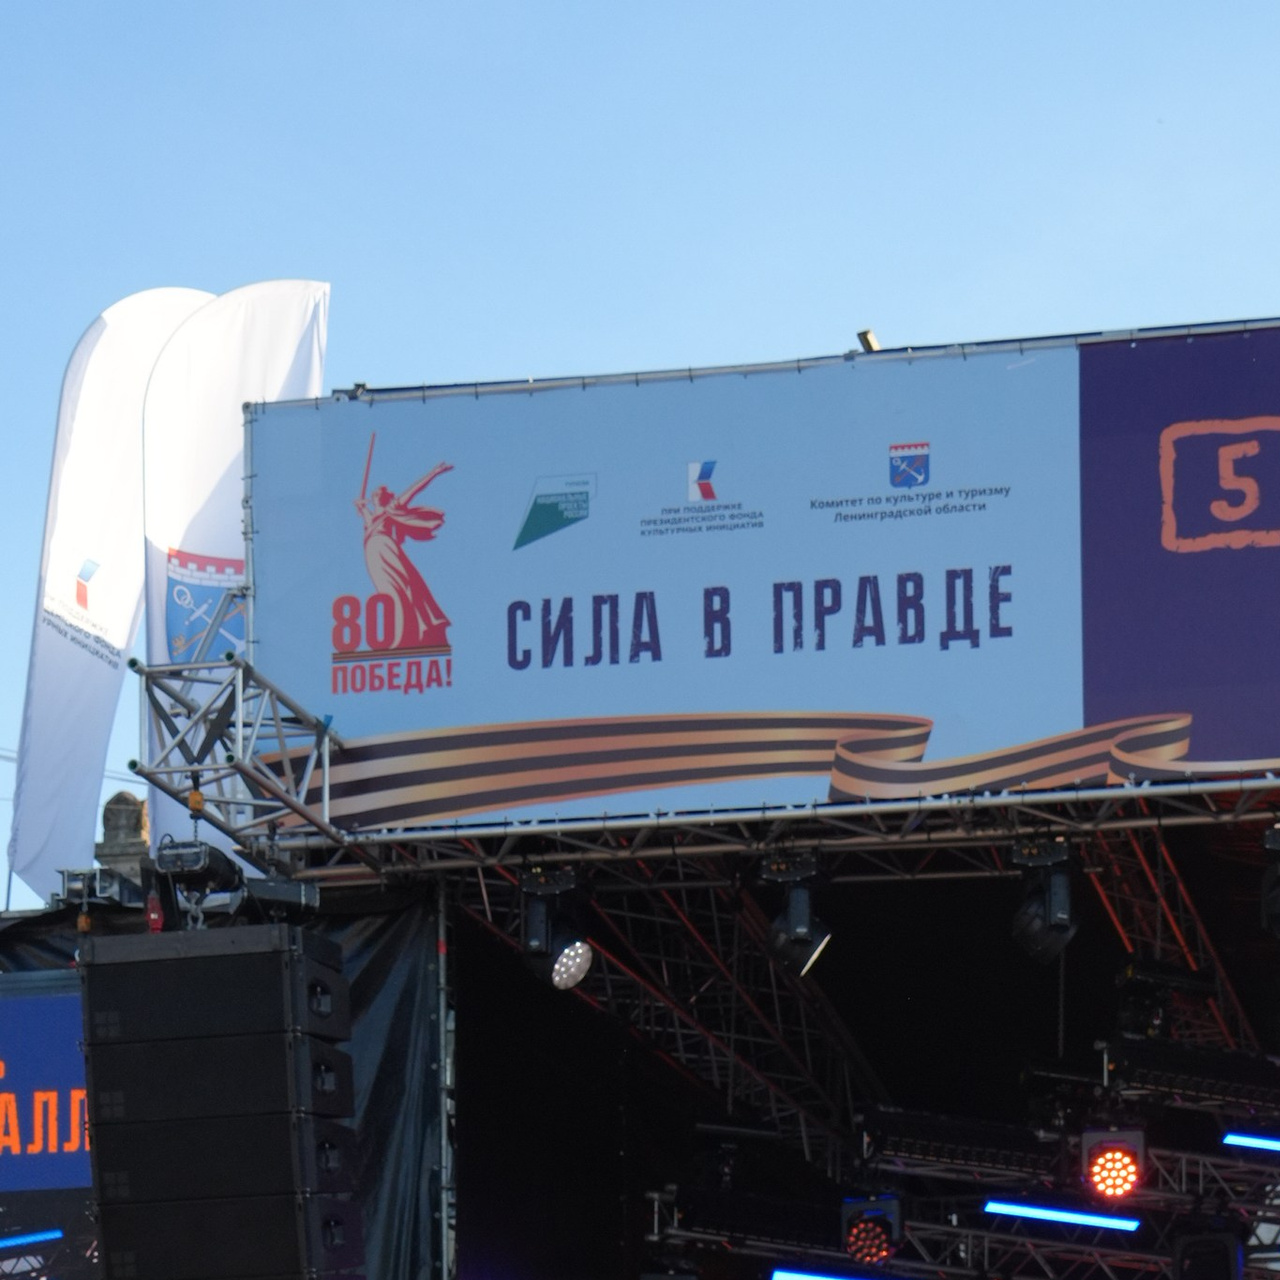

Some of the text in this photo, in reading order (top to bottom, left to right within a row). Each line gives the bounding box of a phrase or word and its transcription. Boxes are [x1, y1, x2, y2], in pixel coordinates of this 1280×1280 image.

[810, 486, 1011, 510] Комитет по культуре и туризму
[833, 502, 987, 523] Ленинградской области
[331, 594, 396, 653] 80
[507, 565, 1013, 671] СИЛА В ПРАВДЕ
[331, 658, 453, 696] ПОБЕДА!
